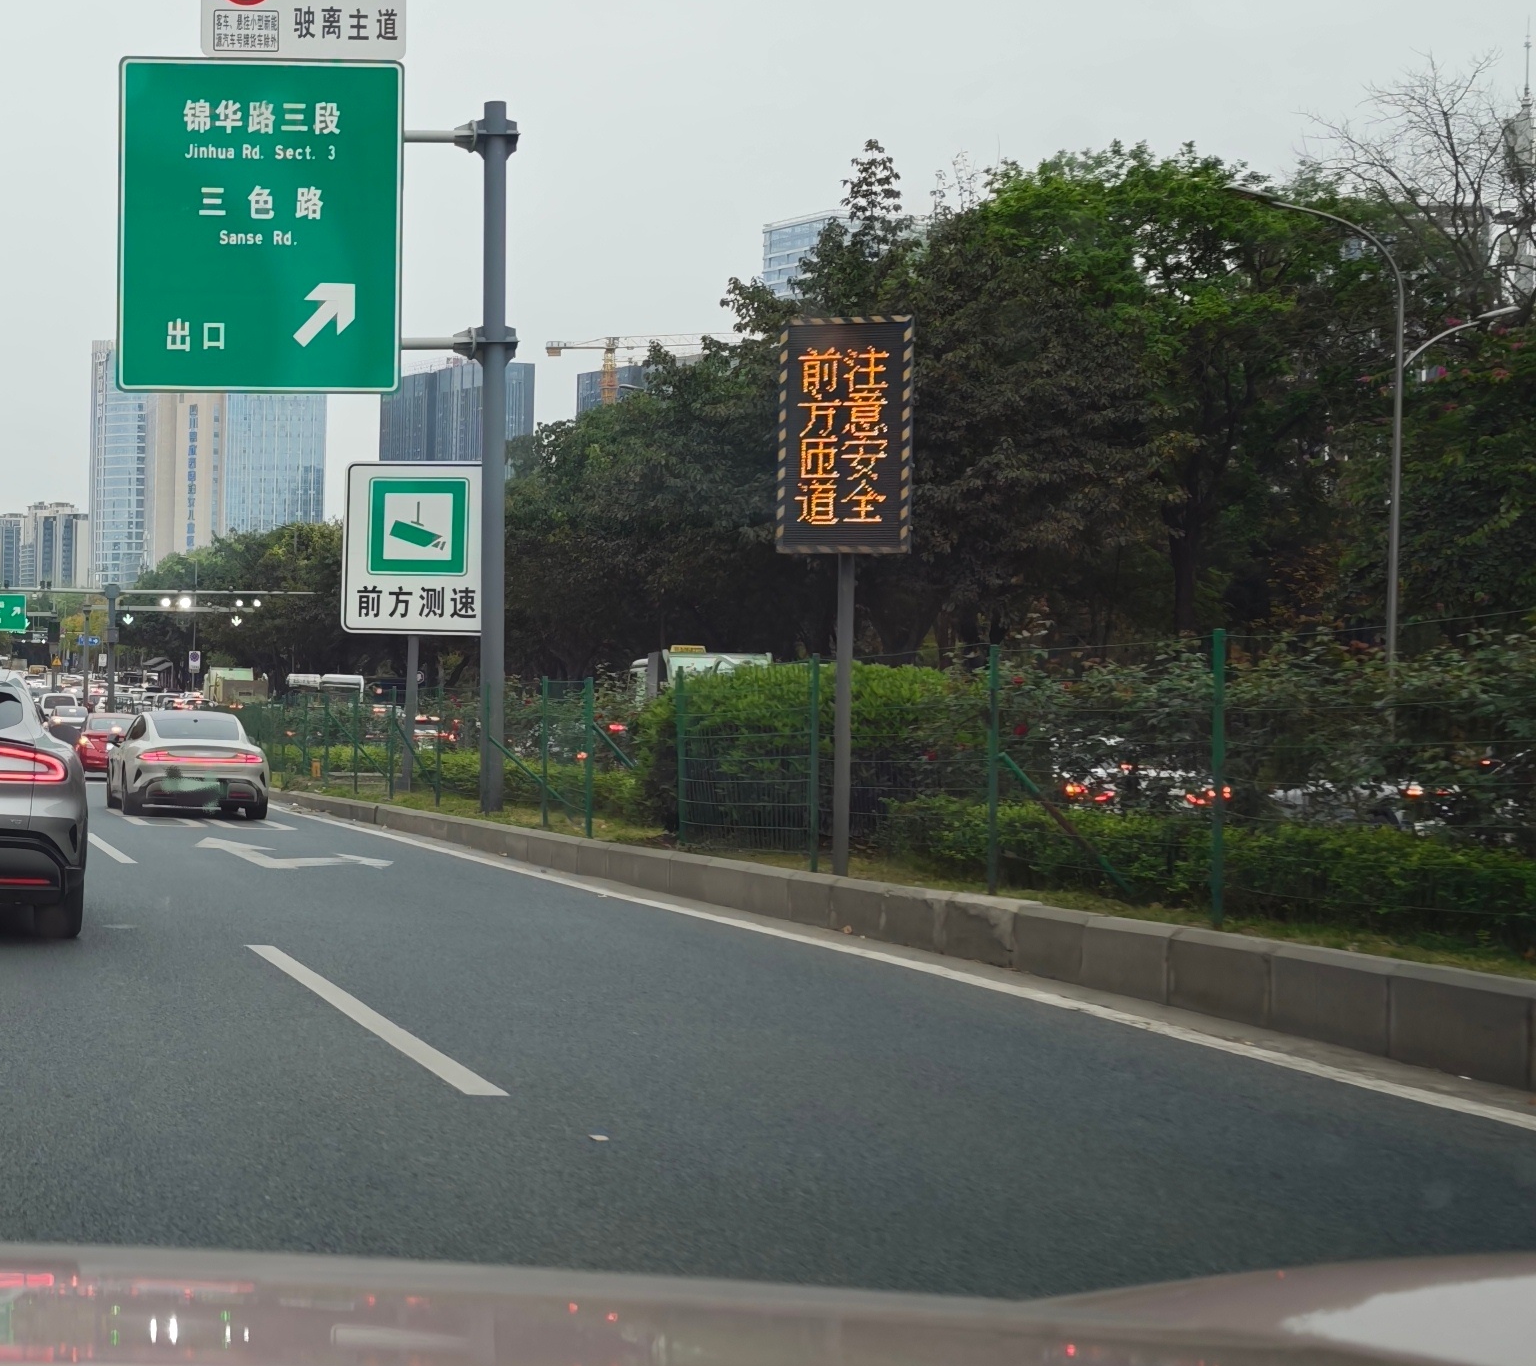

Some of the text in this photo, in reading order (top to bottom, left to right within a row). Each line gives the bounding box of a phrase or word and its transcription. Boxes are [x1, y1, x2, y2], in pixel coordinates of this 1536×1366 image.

[293, 5, 399, 41] 驶离主道
[183, 99, 341, 135] 锦华路三段
[184, 144, 336, 160] Jinhua Rd. Sect. 3
[198, 185, 324, 220] 三色路
[219, 230, 298, 246] Sanse Rd.
[166, 318, 225, 352] 出口
[794, 347, 843, 525] 前方匝道
[841, 346, 889, 523] 注意安全
[357, 586, 477, 619] 前方测速
